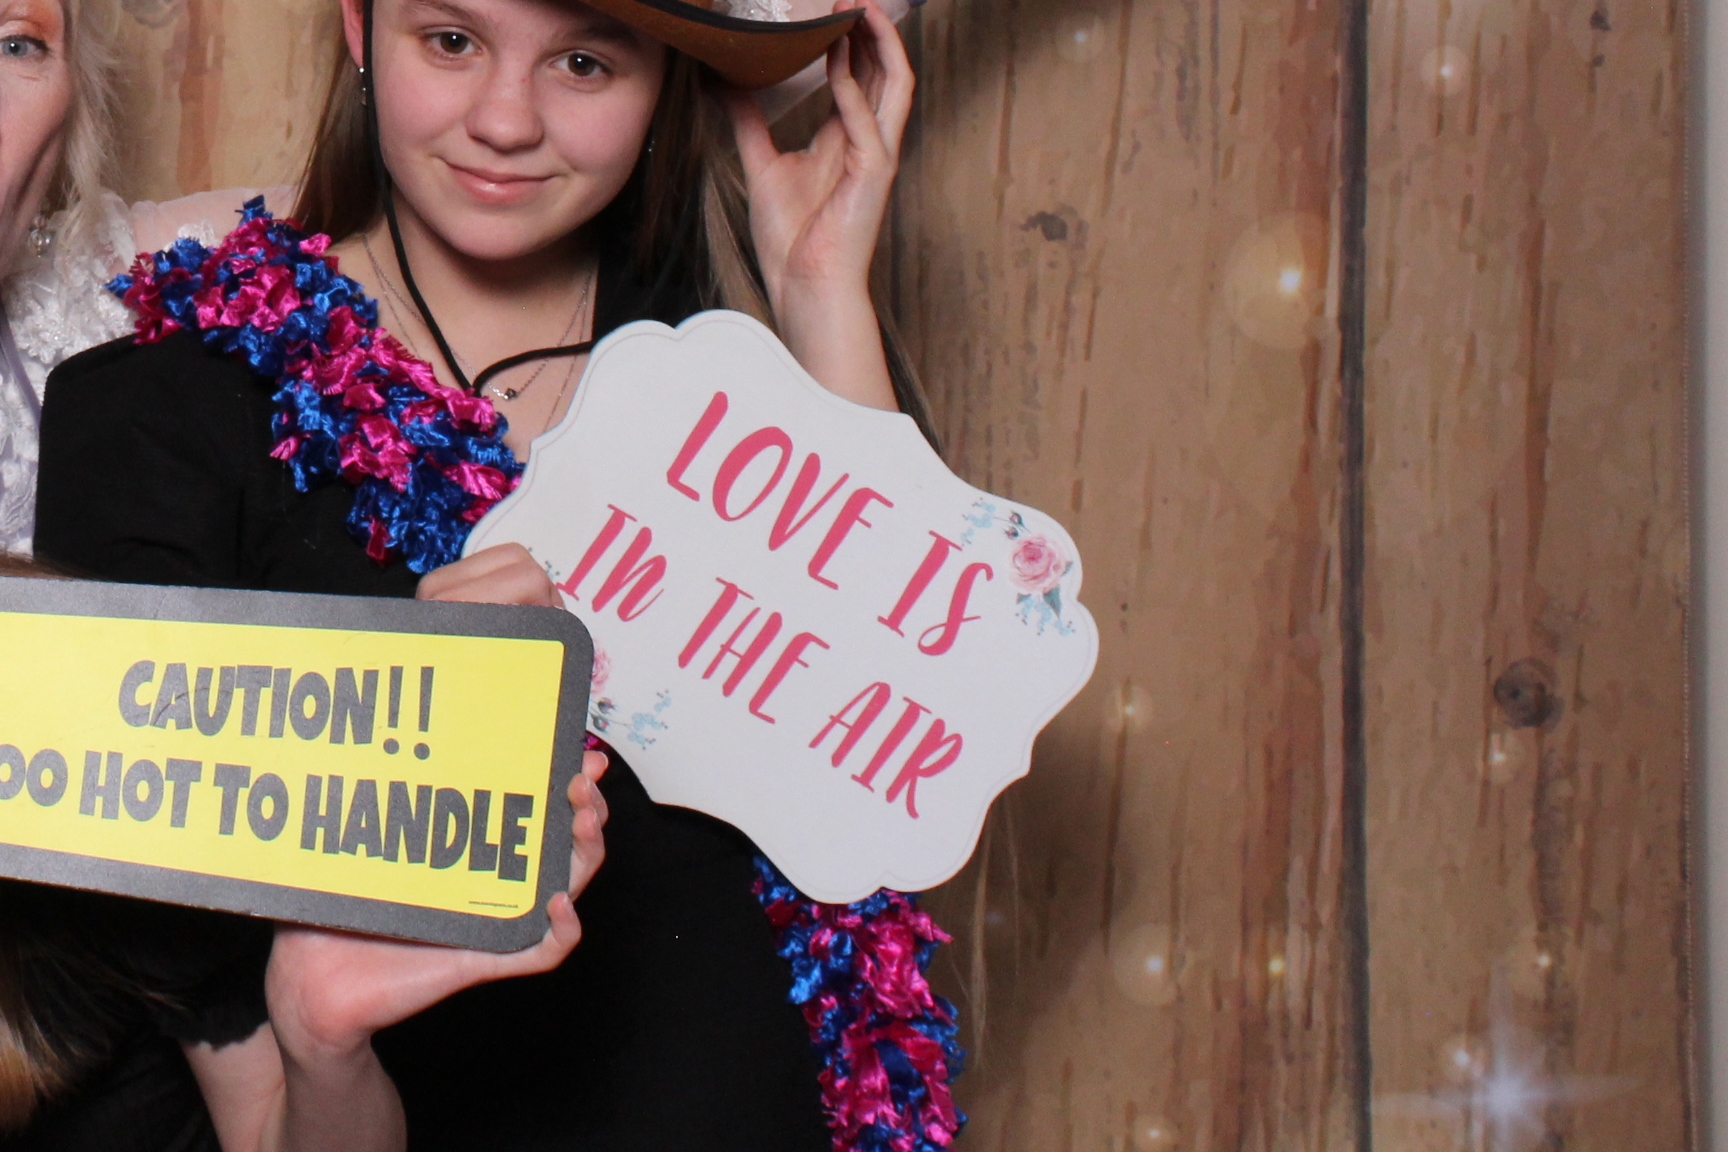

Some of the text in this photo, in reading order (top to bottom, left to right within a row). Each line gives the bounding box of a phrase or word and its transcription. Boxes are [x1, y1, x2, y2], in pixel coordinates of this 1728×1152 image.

[666, 390, 994, 656] LOVE IS
[117, 659, 435, 760] CAUTION!!
[678, 576, 830, 724] THE
[808, 681, 963, 819] AIR
[78, 750, 204, 829] HOT
[212, 762, 289, 841] TO
[300, 772, 535, 883] HANDLE
